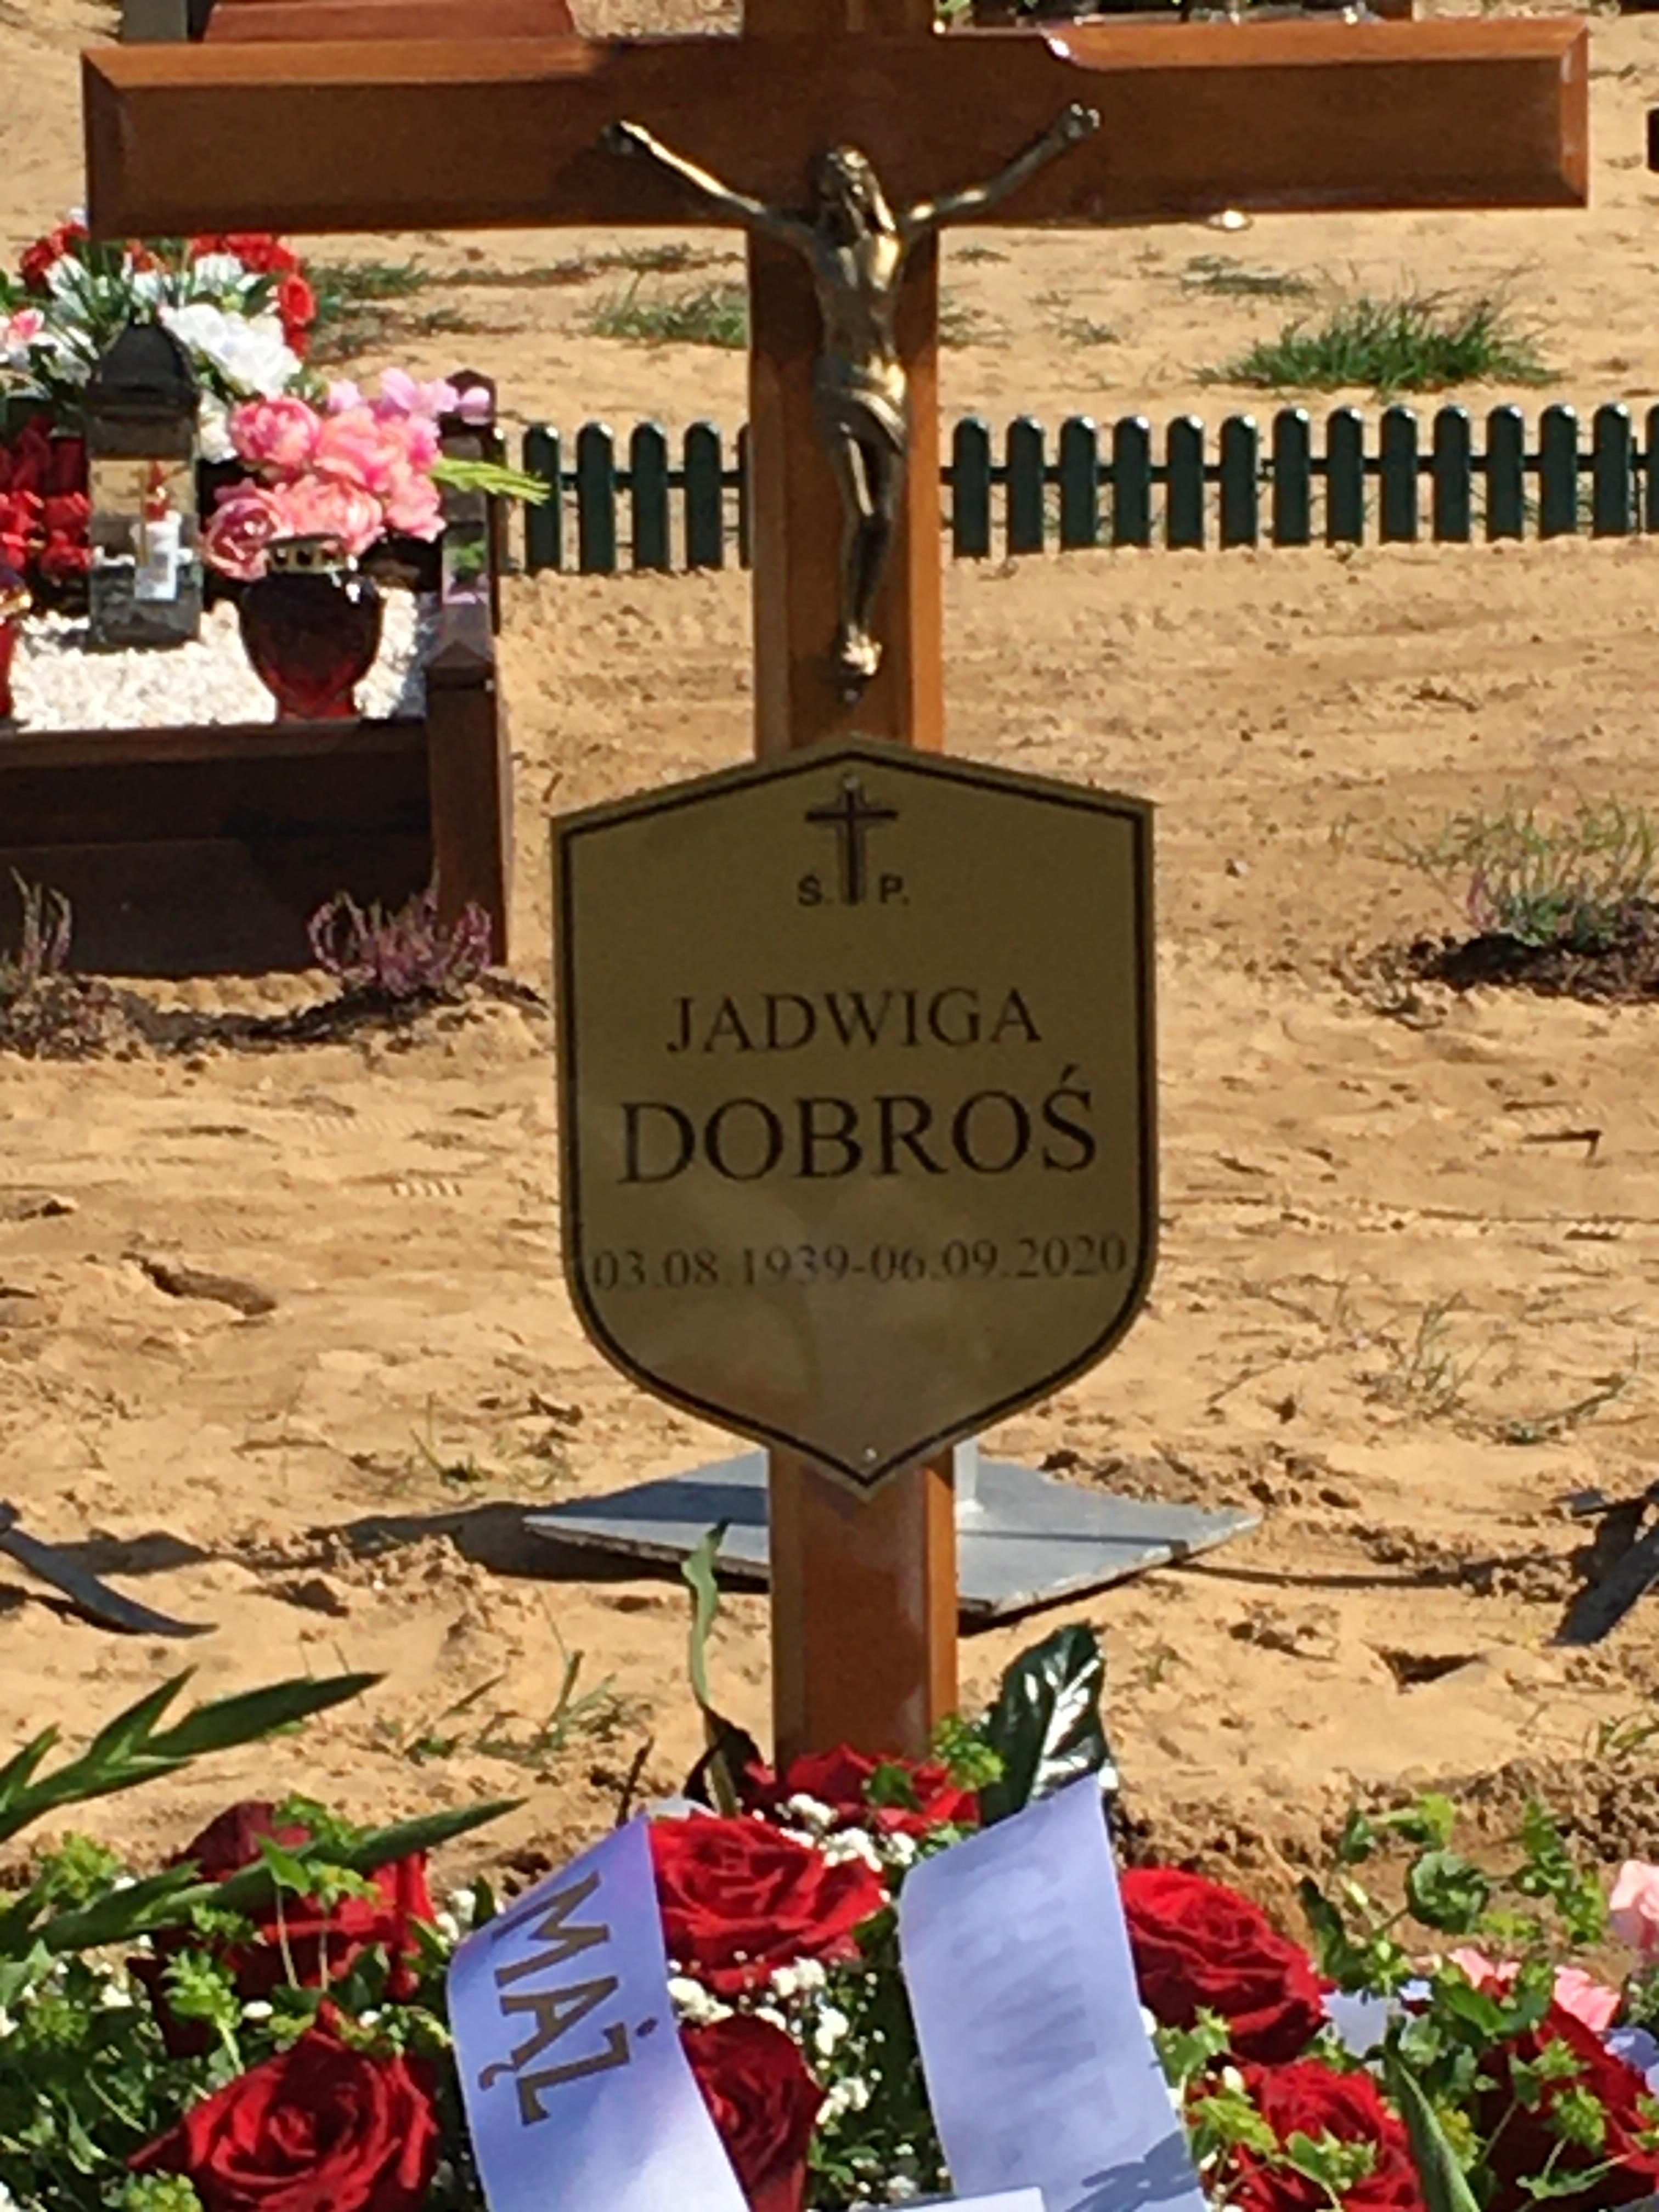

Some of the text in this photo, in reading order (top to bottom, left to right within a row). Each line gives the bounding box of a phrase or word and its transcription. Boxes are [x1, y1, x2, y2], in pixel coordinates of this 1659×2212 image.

[666, 987, 1042, 1053] JADWIGA
[618, 1064, 1096, 1184] DOBROŚ
[479, 1871, 658, 2125] MĄŻ
